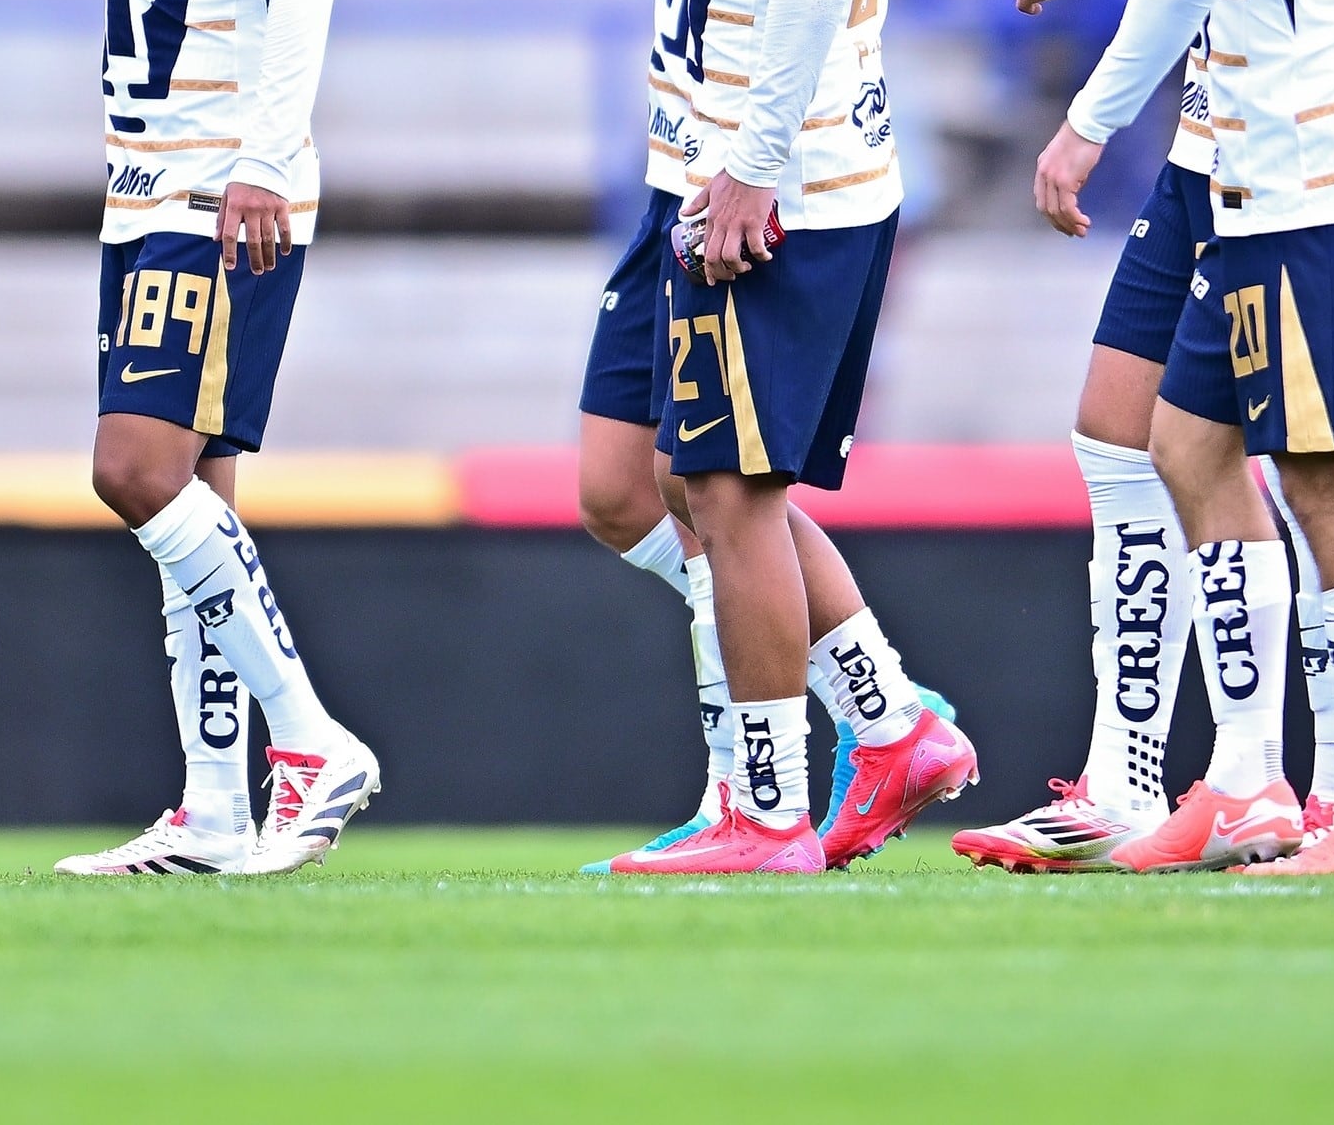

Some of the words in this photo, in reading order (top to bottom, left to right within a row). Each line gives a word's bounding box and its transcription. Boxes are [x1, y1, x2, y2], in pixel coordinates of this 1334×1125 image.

[115, 269, 213, 355] 189
[667, 313, 731, 402] 27
[1222, 284, 1269, 379] 20
[1116, 522, 1169, 723] CREST
[1197, 540, 1260, 701] CRES
